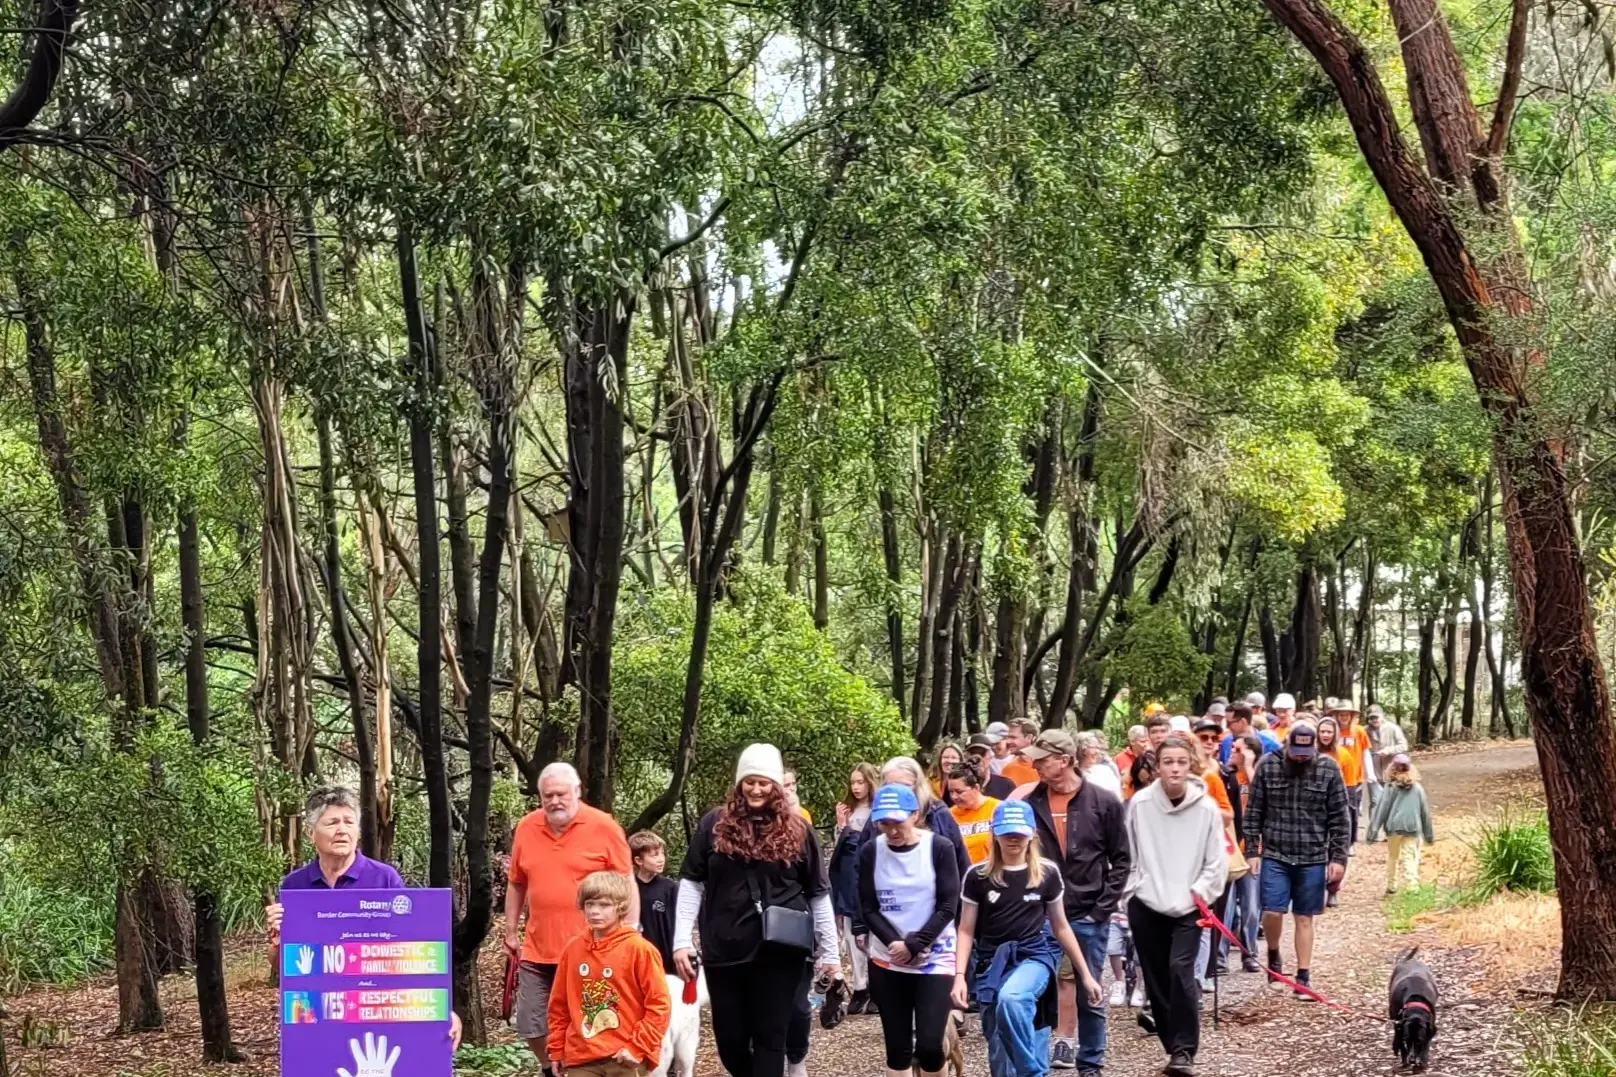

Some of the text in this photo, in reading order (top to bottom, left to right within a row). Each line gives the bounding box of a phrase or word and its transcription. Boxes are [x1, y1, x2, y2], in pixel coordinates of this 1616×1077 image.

[360, 900, 392, 911] Rotary
[361, 944, 425, 958] DOMESTIC
[323, 945, 346, 974] NO
[361, 959, 437, 974] FAMILY VIOLENCE
[360, 988, 437, 1005] RESPECTFUL
[322, 991, 346, 1020] YES
[361, 1005, 437, 1019] RELATIONSHIPS
